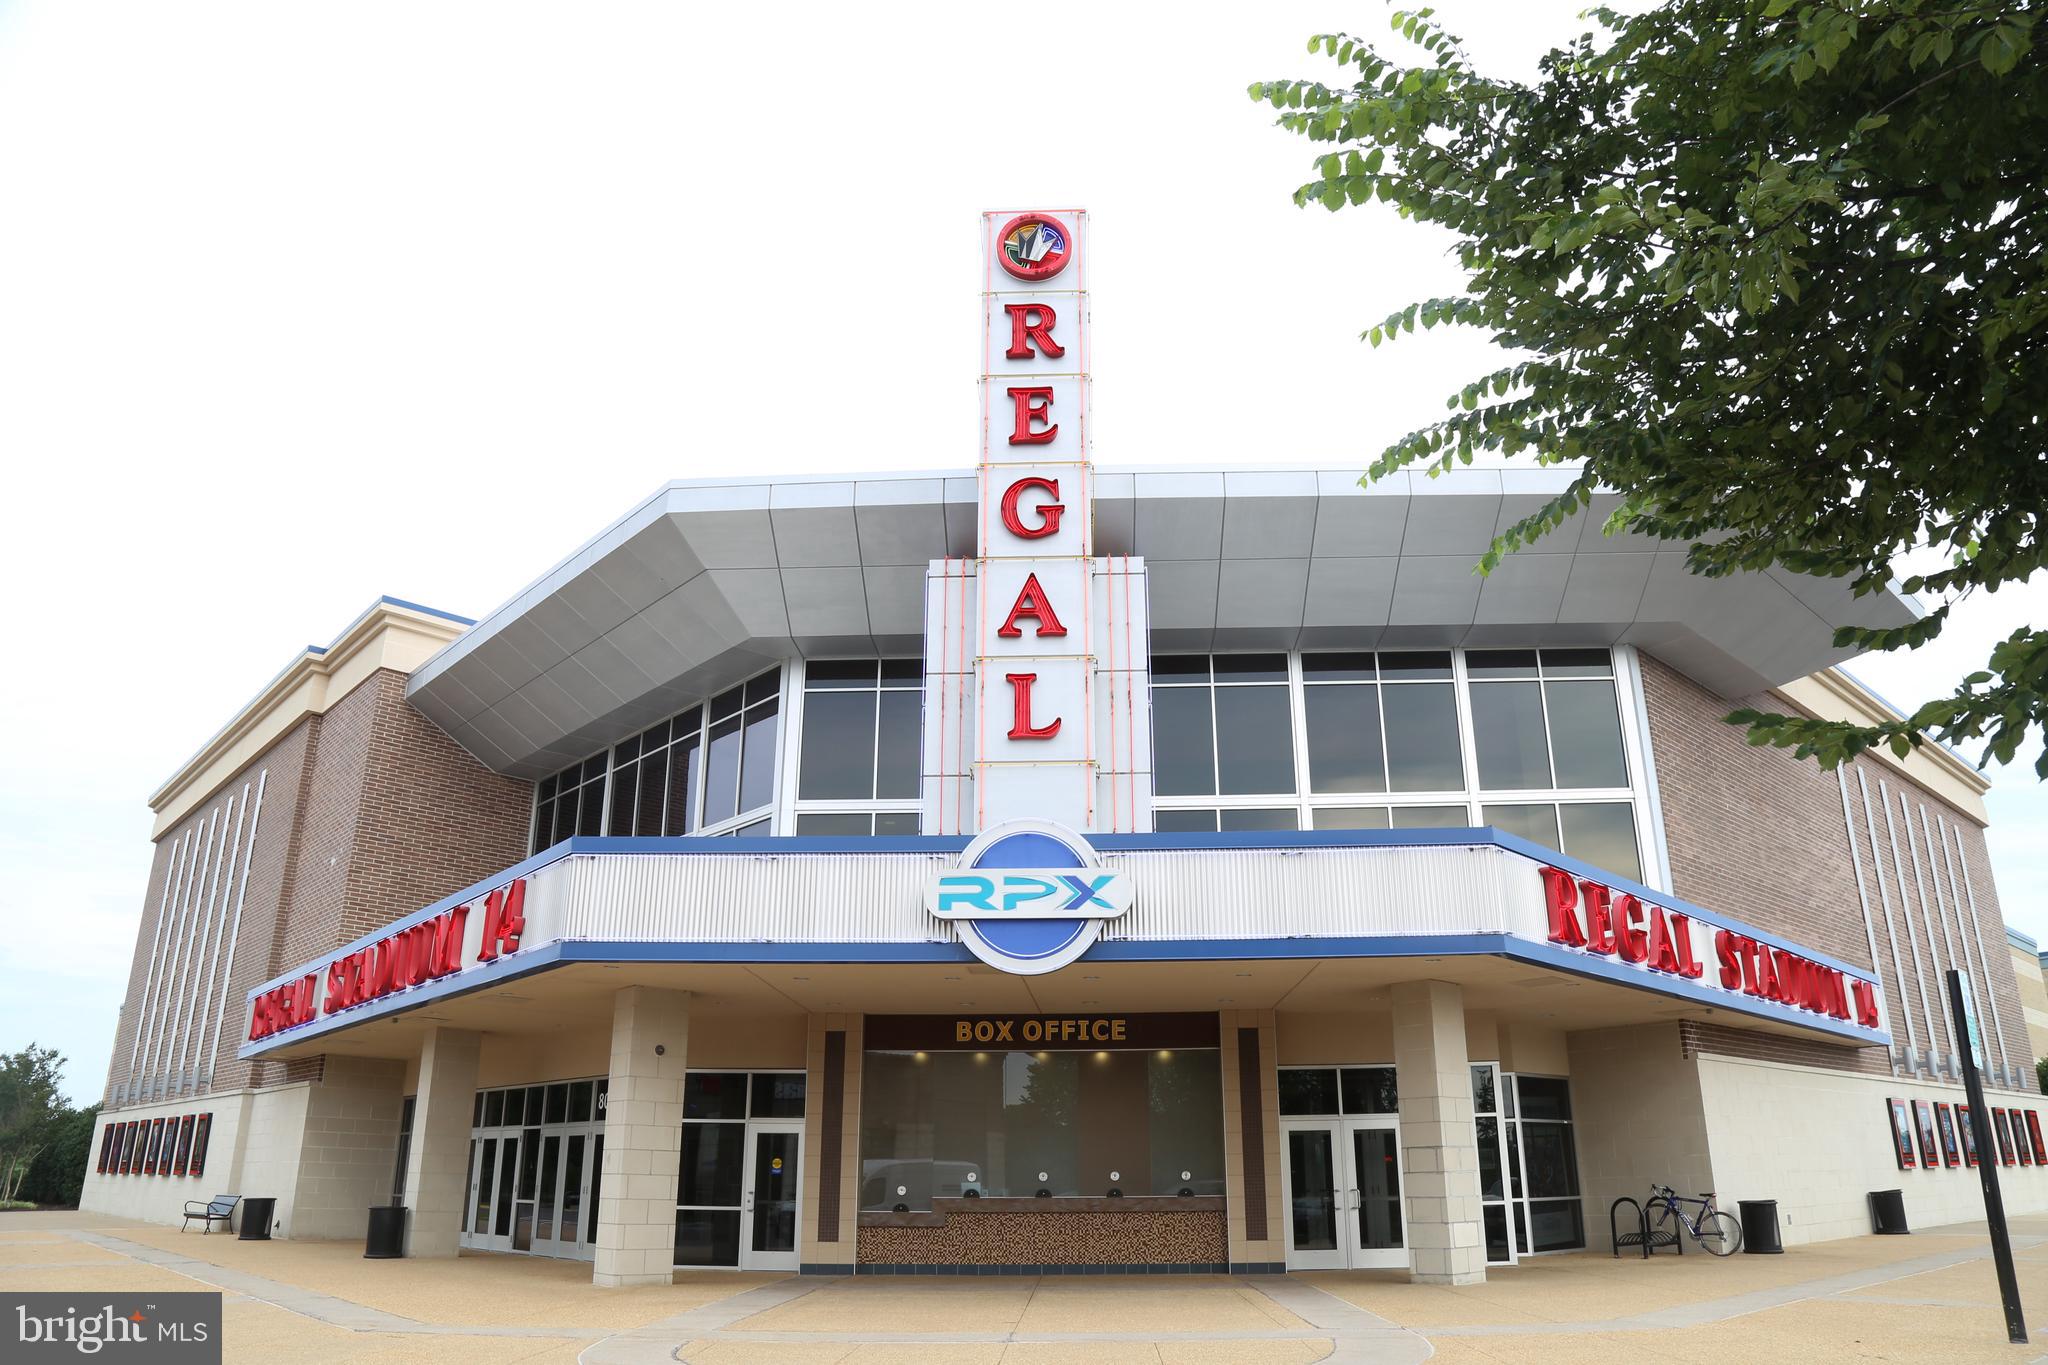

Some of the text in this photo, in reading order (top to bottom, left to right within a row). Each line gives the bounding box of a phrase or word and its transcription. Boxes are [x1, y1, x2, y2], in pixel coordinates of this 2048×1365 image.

[998, 303, 1067, 741] REGAL
[323, 906, 470, 1015] STADIUM
[477, 878, 526, 962] 14
[938, 875, 1118, 911] RPX
[1539, 866, 1704, 979] REGAL
[1714, 930, 1851, 1020] STADIUM
[1852, 979, 1880, 1028] 14
[956, 1019, 1126, 1042] BOX OFFICE
